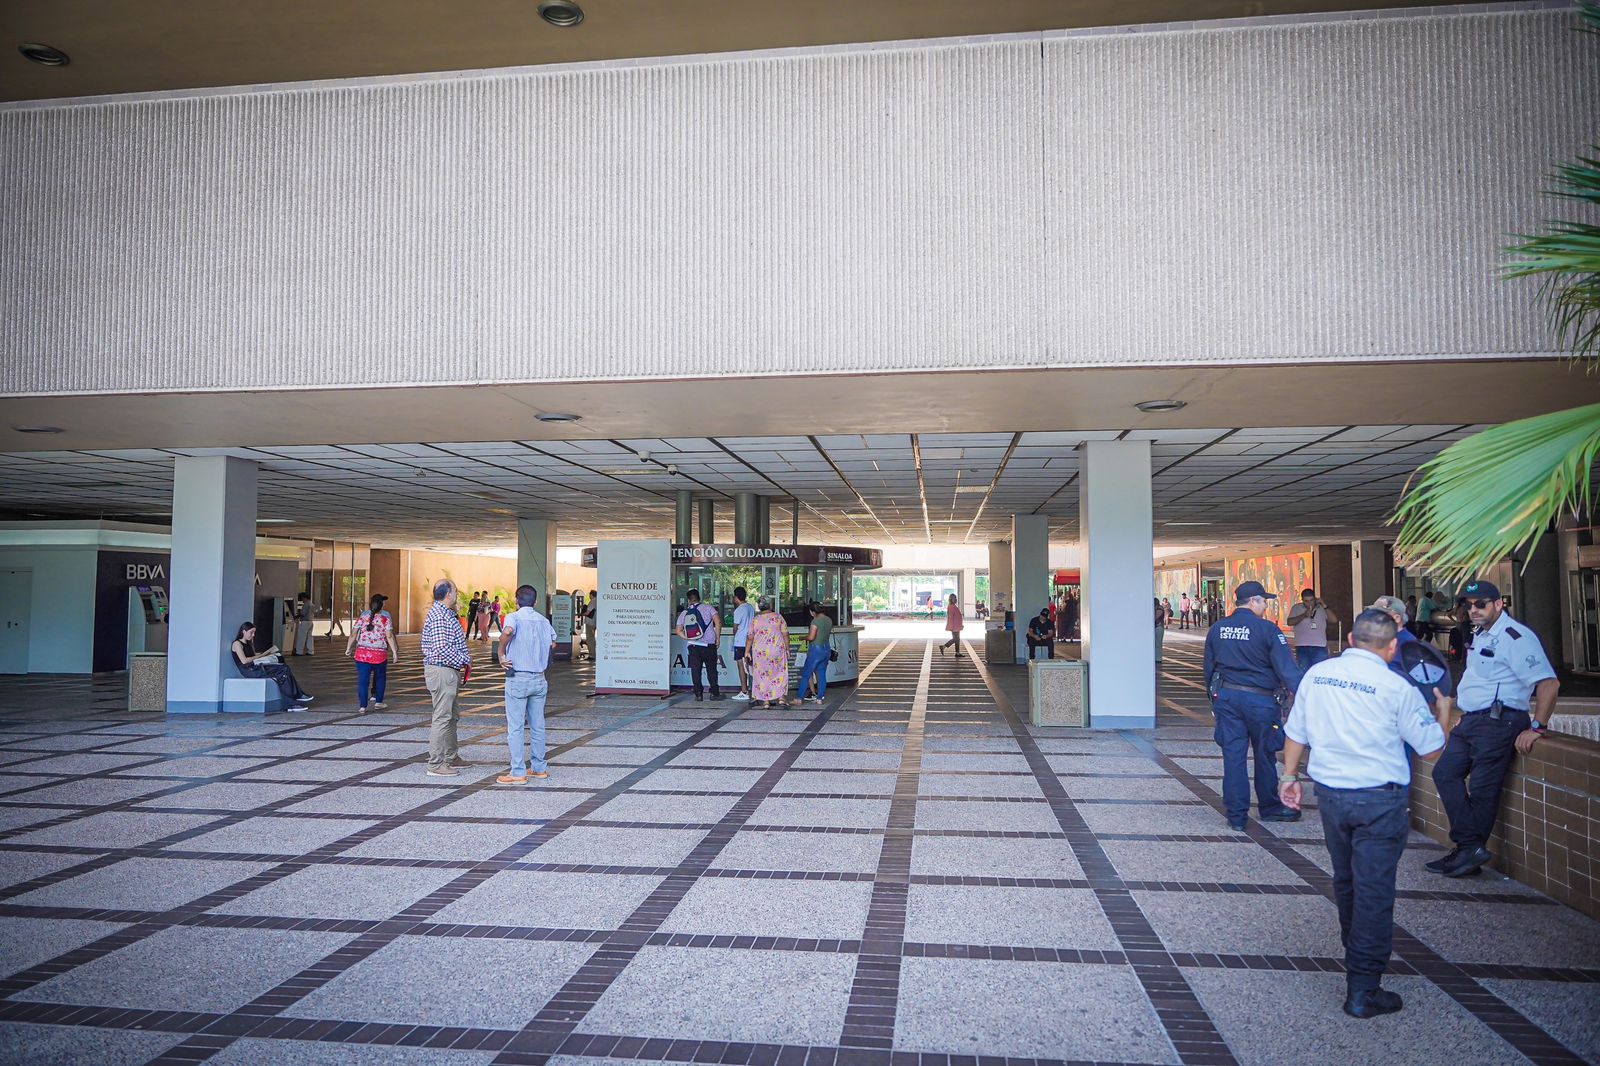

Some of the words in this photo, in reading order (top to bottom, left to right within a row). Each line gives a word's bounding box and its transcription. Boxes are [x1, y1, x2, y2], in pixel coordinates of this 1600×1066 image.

[672, 546, 723, 559] TENCIÓN
[726, 548, 798, 559] CIUDADANA
[827, 552, 853, 560] SINALOA
[126, 564, 166, 580] BBVA
[610, 582, 645, 591] CENTRO
[646, 582, 658, 591] DE
[766, 577, 774, 589] 3
[602, 593, 666, 601] CREDENCIALIZACIÓN
[1219, 626, 1250, 635] POLICÍA
[1219, 633, 1250, 641] ESTATAL
[1313, 676, 1348, 689] SEGURIDAD
[1349, 682, 1377, 695] PRIVADA
